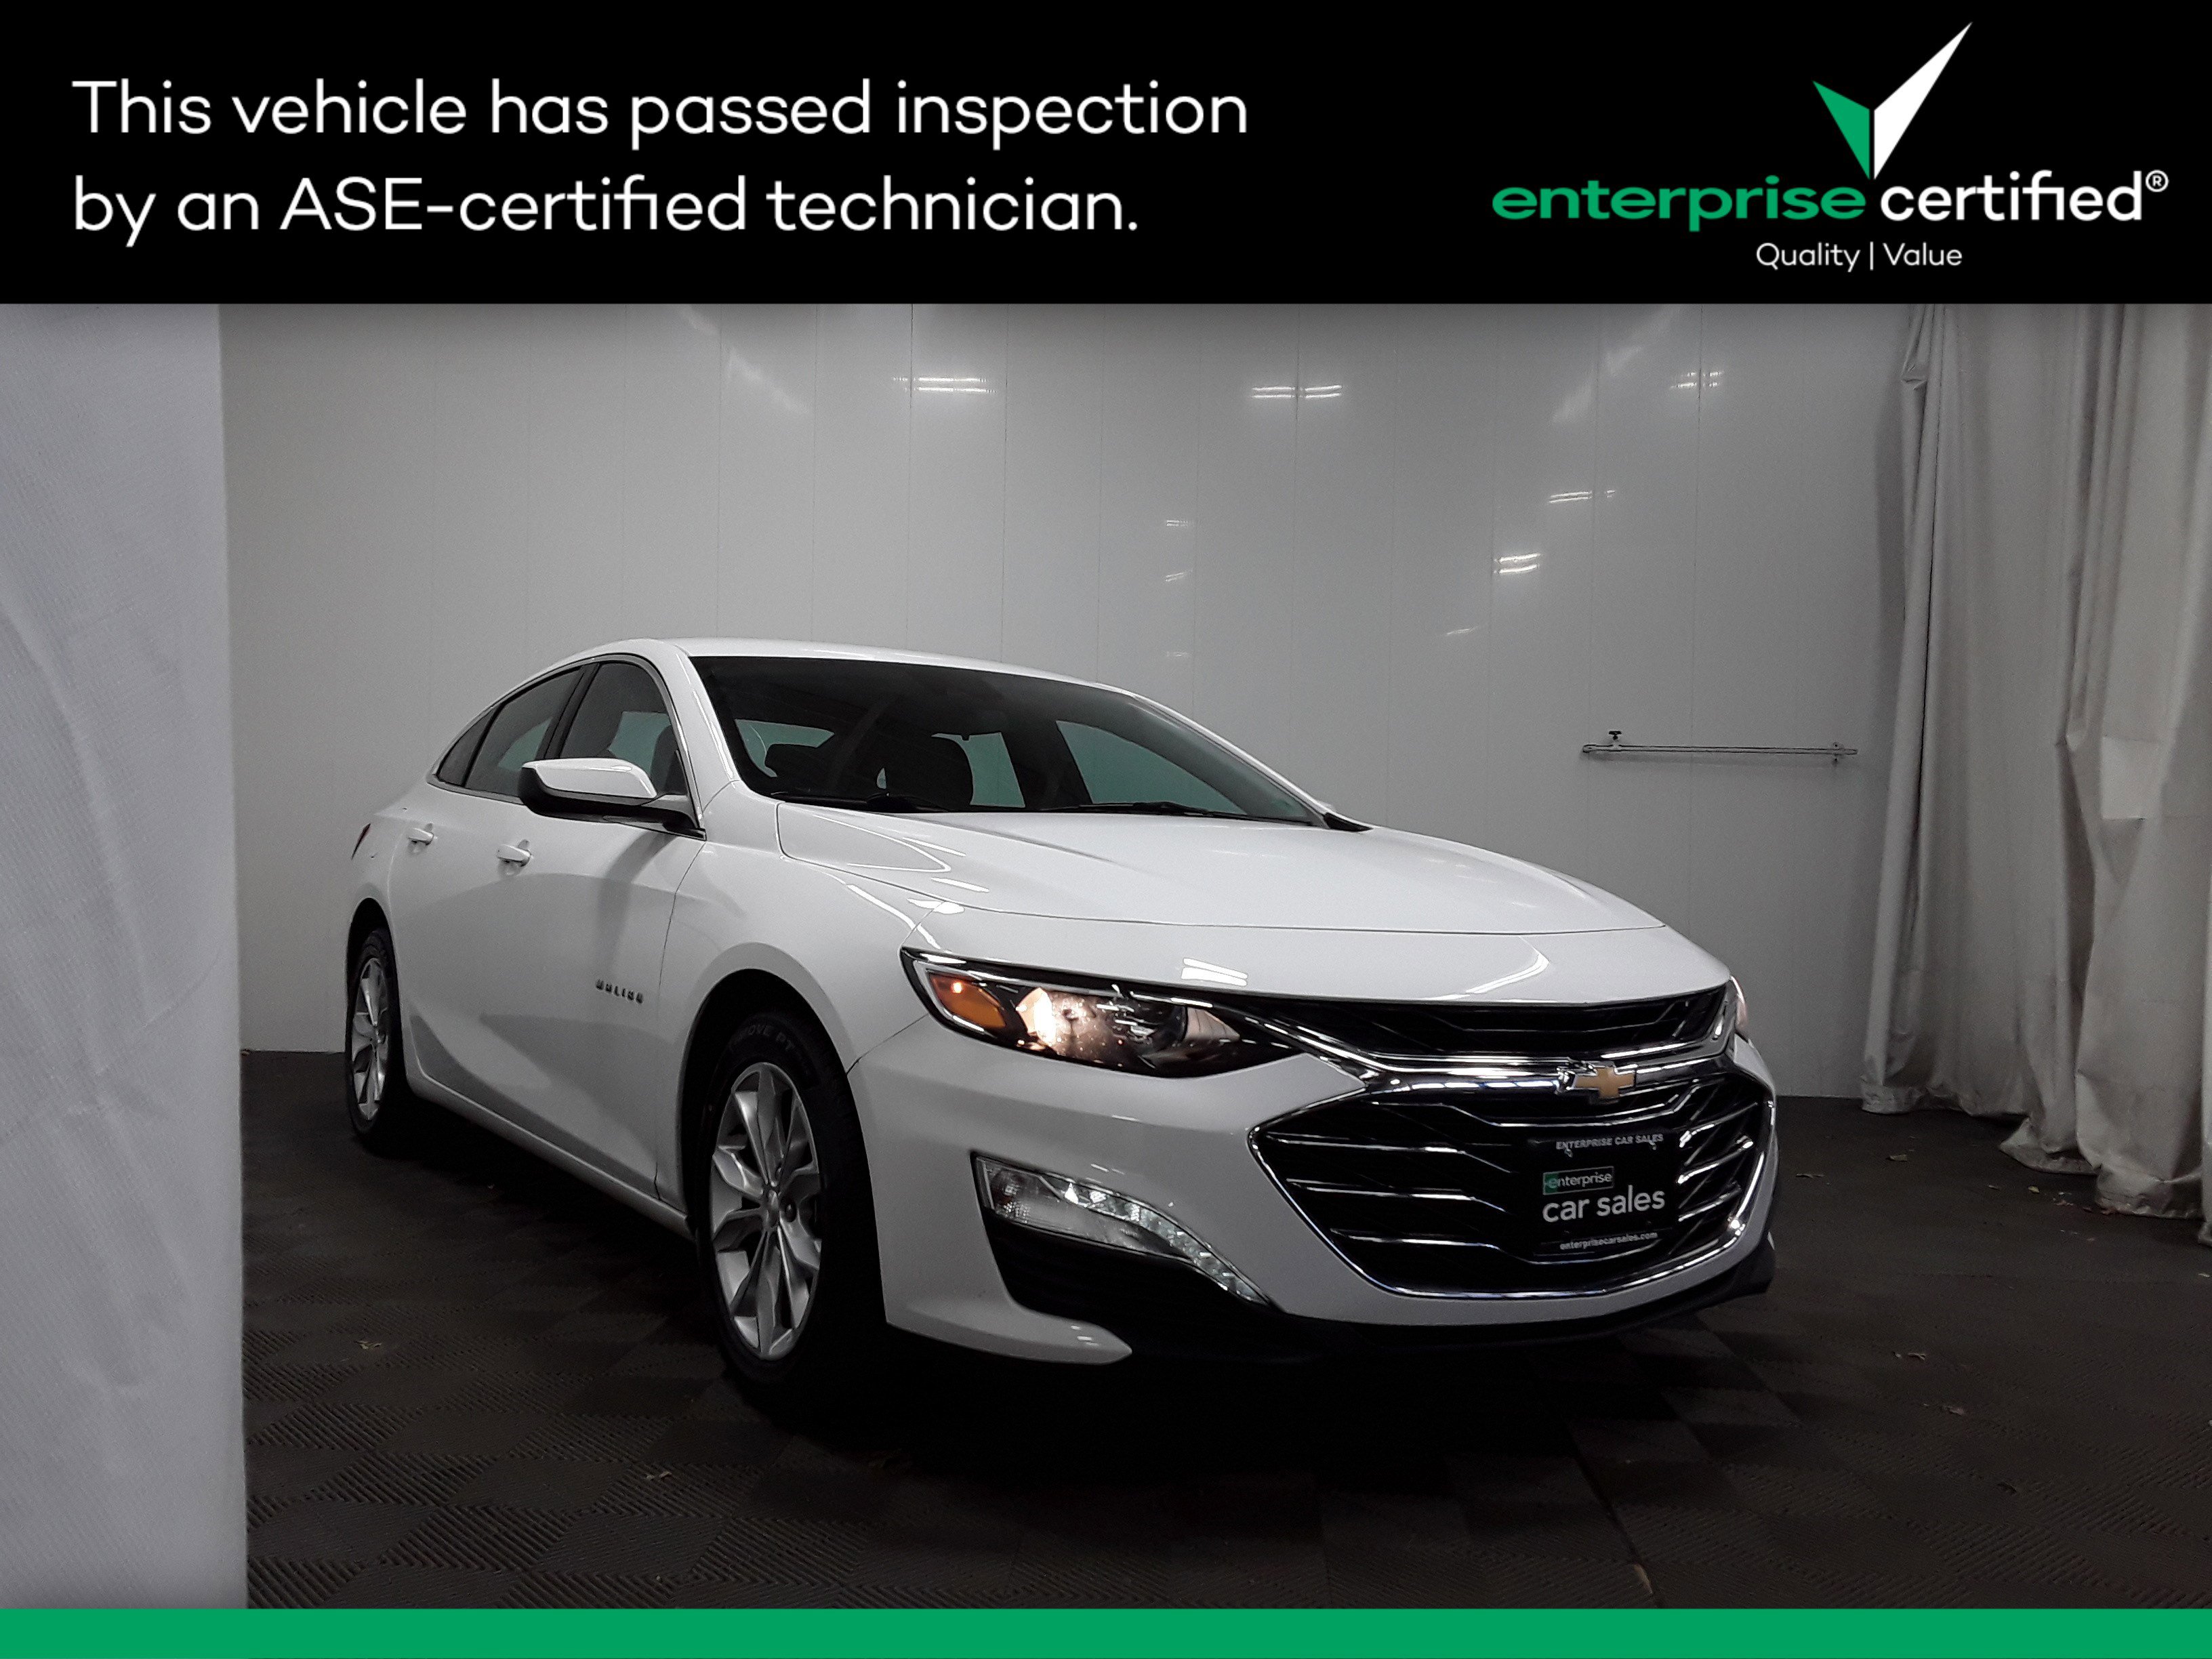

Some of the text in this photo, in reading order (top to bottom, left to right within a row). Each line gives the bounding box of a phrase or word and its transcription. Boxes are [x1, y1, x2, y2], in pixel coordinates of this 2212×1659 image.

[1555, 1133, 1664, 1150] ENTERPRISE CAR SALES
[1547, 1172, 1613, 1189] enterprise
[1542, 1184, 1665, 1223] car sales
[1559, 1232, 1658, 1250] enterprisecarsales.com
